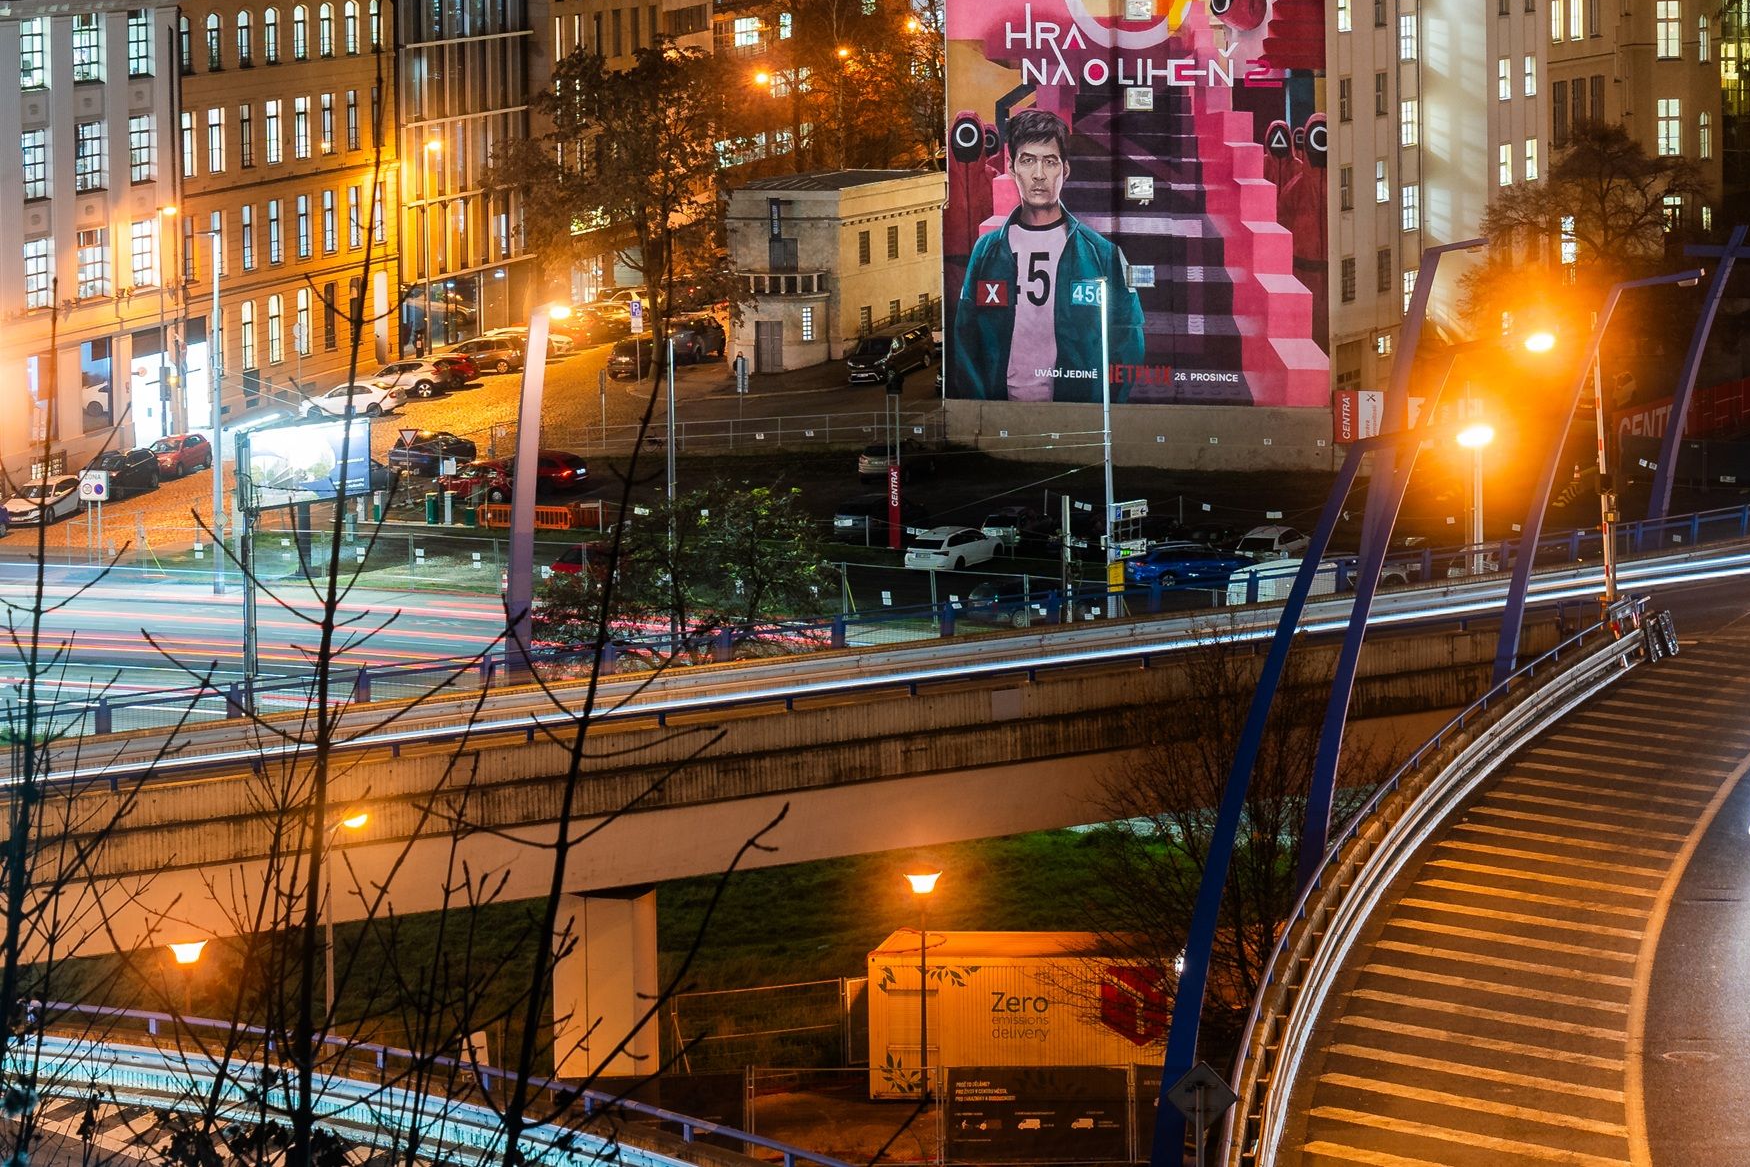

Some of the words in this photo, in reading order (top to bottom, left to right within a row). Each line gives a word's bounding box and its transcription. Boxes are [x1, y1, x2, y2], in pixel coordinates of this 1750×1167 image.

[1005, 3, 1087, 51] HRA
[1243, 59, 1283, 88] 2
[985, 283, 1000, 304] X
[1034, 367, 1063, 378] UVÁDÍ
[1063, 367, 1098, 379] JEDINĚ
[1174, 372, 1188, 382] 26.
[1190, 372, 1239, 383] PROSINCE
[991, 991, 1049, 1013] Zero
[991, 1016, 1049, 1026] emissions
[991, 1026, 1050, 1043] delivery
